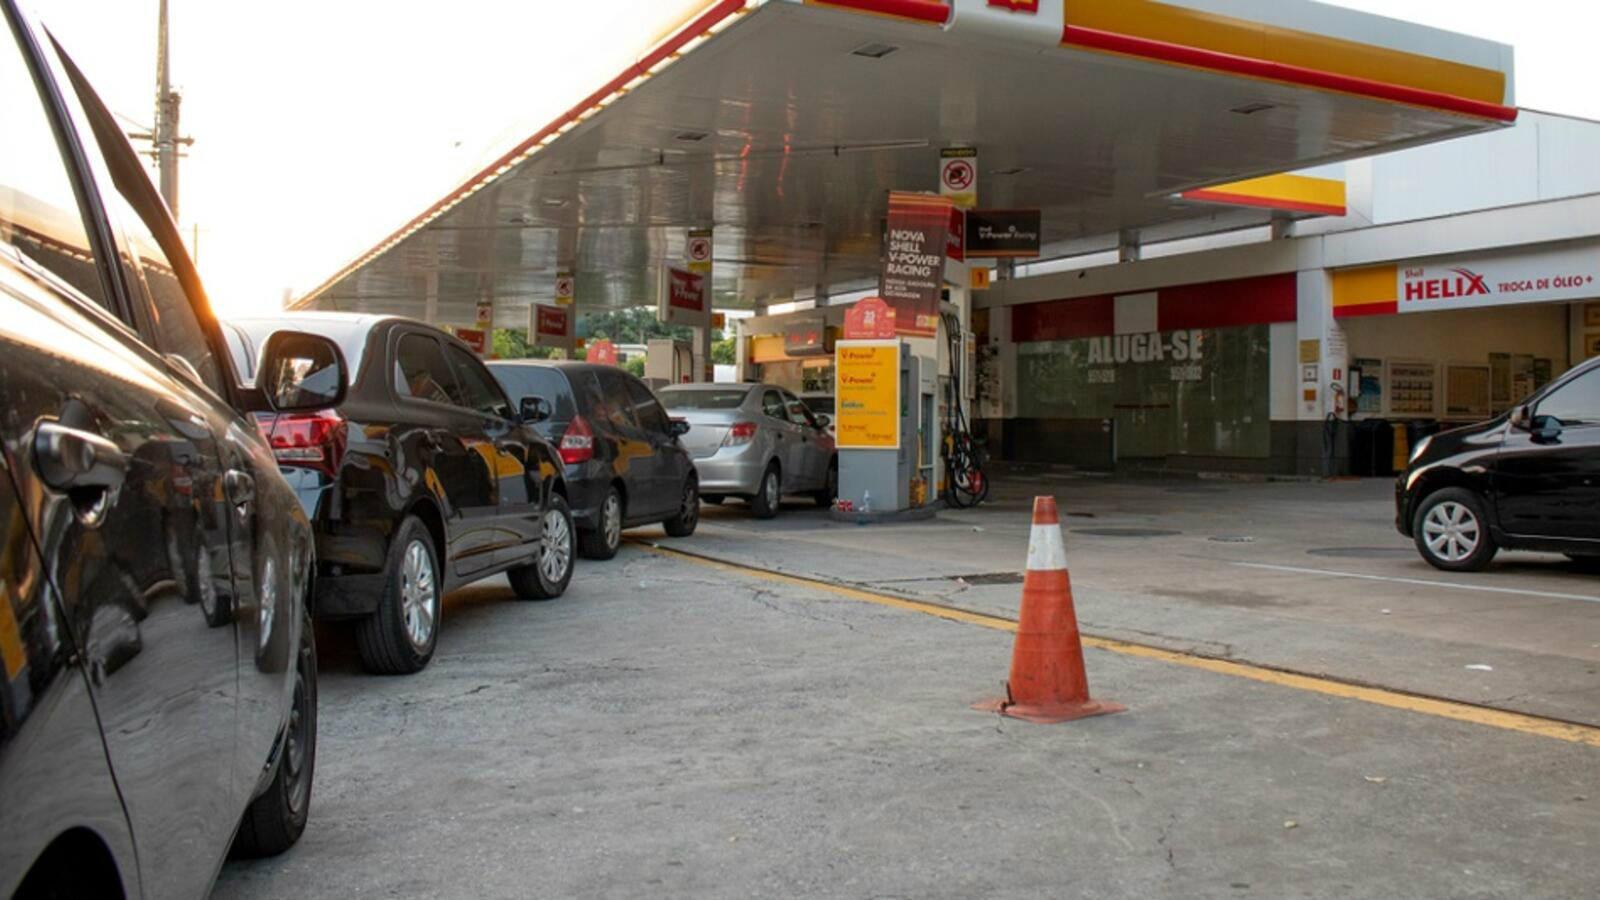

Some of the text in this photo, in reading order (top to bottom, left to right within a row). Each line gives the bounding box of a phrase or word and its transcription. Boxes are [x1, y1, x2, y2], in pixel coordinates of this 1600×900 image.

[890, 229, 925, 242] NOVA
[979, 231, 1012, 239] V-Power
[889, 240, 921, 253] SHELL
[888, 251, 940, 266] V-POWER
[887, 262, 931, 278] RACING
[1405, 268, 1424, 279] Shell
[1405, 273, 1488, 301] HELIX
[1497, 281, 1533, 293] TROCA
[1537, 278, 1549, 290] DE
[1553, 275, 1584, 289] ÓLEO
[1087, 329, 1204, 364] ALUGA-SE
